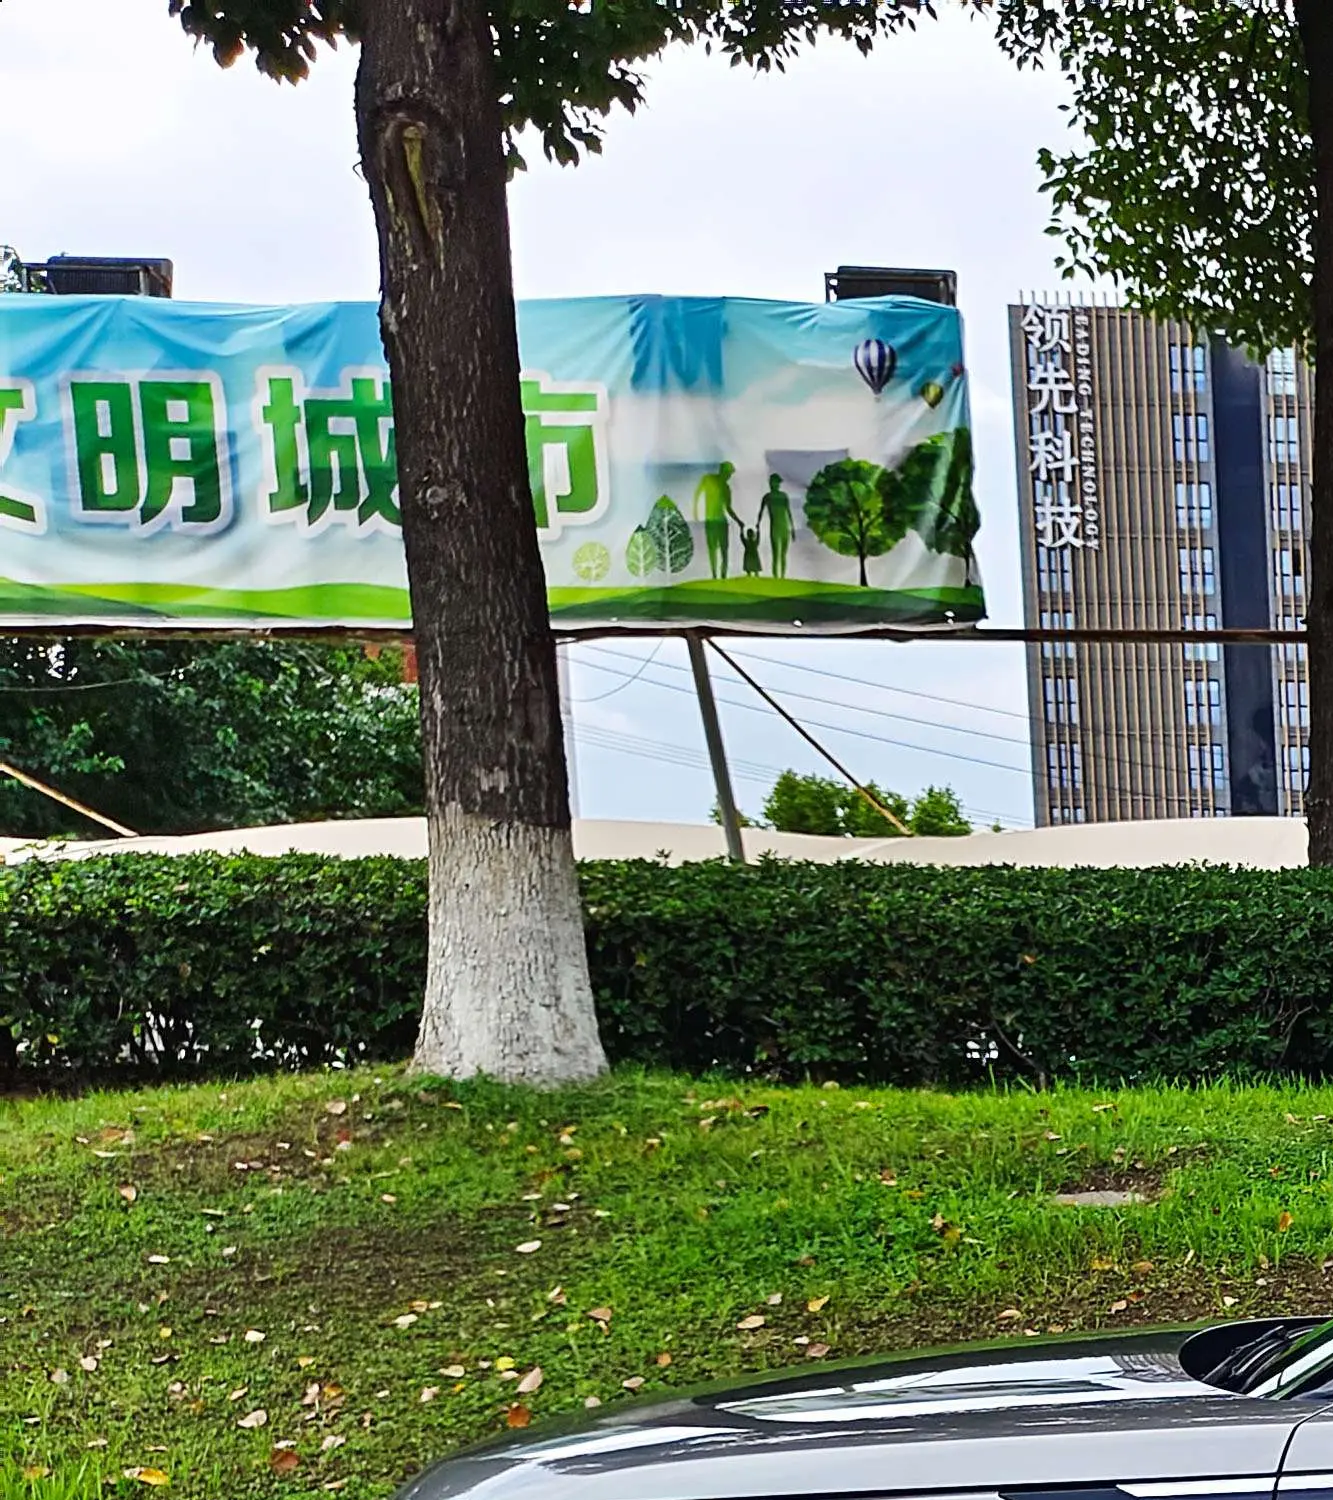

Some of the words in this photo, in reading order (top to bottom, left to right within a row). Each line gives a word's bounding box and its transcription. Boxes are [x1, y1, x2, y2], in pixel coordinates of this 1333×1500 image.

[0, 375, 598, 528] 明城市
[1020, 302, 1085, 548] 领先科技
[1079, 408, 1100, 551] TECHNOLOGY
